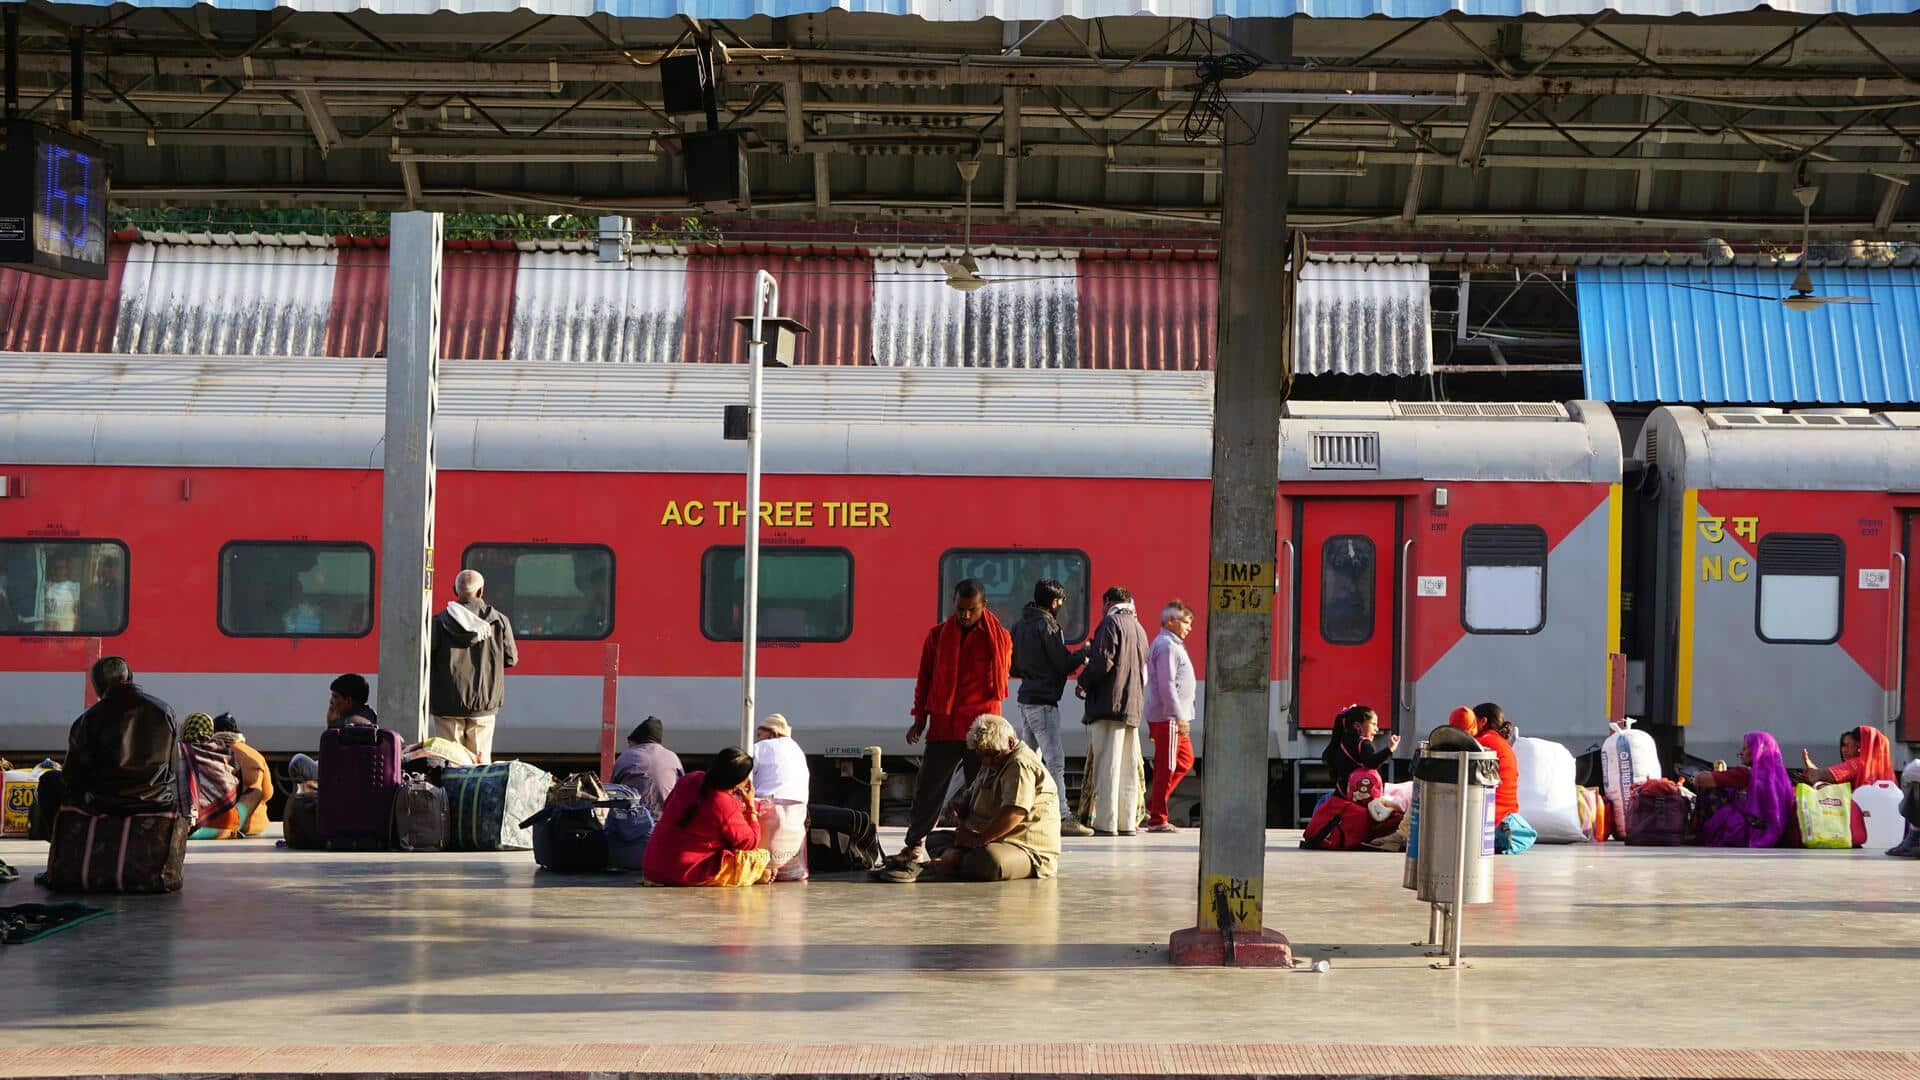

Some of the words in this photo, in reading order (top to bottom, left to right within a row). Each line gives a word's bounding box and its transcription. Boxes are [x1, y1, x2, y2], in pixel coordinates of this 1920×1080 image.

[660, 500, 704, 527] AC
[823, 501, 891, 528] TIER
[1223, 563, 1262, 582] IMP
[12, 789, 34, 807] 30
